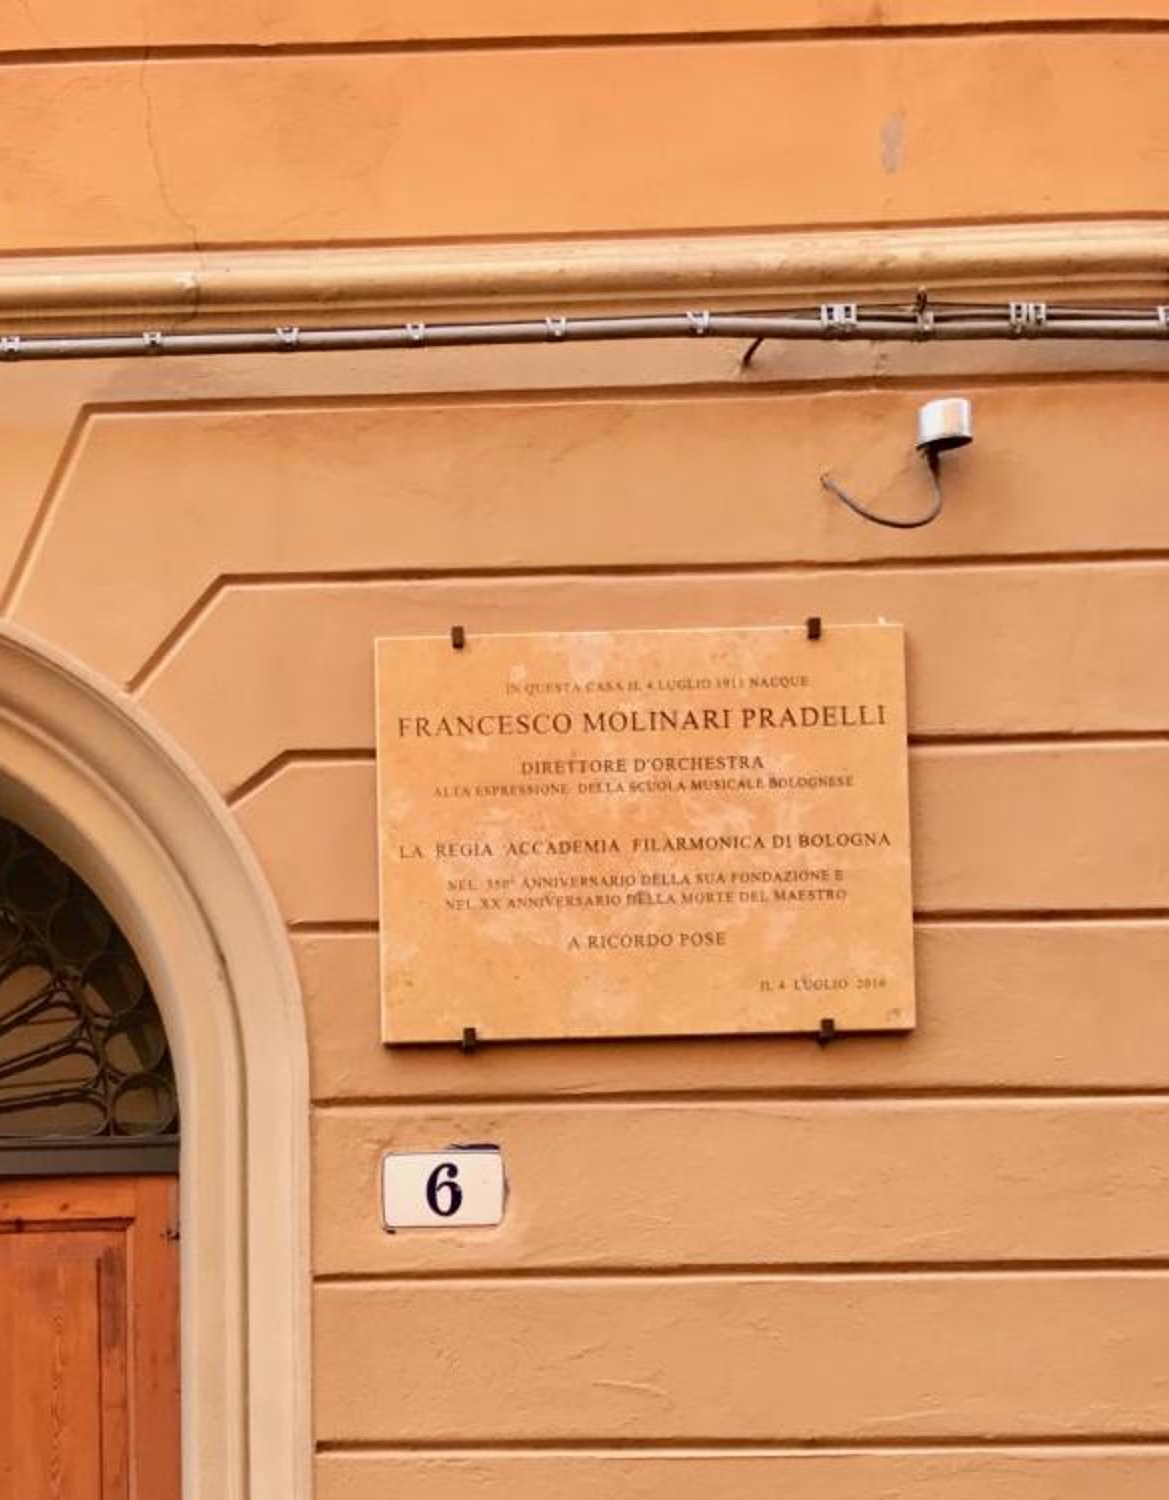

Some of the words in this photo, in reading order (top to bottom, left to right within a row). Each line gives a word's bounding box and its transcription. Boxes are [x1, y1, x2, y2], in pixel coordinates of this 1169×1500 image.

[506, 683, 521, 695] IN
[524, 682, 581, 697] QUESTA
[586, 681, 623, 693] CASA
[627, 680, 642, 692] IL
[646, 680, 654, 691] 4
[658, 678, 711, 691] LUGLIO
[716, 677, 745, 690] 1911
[749, 676, 811, 689] NACQUE
[398, 713, 573, 738] FRANCESCO
[582, 708, 731, 734] MOLINARI
[742, 704, 887, 729] PRADELLI
[521, 759, 628, 775] DIRETTORE
[634, 755, 765, 772] D'ORCHESTRA
[434, 786, 471, 799] ALTA
[578, 782, 624, 795] DELLA
[628, 779, 684, 793] SCUOLA
[690, 777, 765, 791] MUSICALE
[768, 775, 854, 789] BOLOGNESE
[399, 845, 424, 859] LA
[435, 842, 493, 857] REGIA
[507, 838, 621, 856] ACCADEMIA
[632, 835, 766, 851] FILARMONICA
[772, 835, 792, 849] DI
[798, 833, 891, 848] BOLOGNA
[447, 879, 479, 892] NEL
[522, 874, 637, 889] ANNIVERSARIO
[641, 872, 691, 886] DELLA
[695, 871, 726, 885] SUA
[731, 869, 830, 884] FONDAZIONE
[834, 869, 844, 881] E
[446, 898, 471, 911] NEL
[479, 897, 506, 910] XX
[507, 894, 622, 909] ANNIVERSARIO
[626, 892, 677, 906] DELLA
[681, 890, 736, 904] MORTE
[739, 890, 768, 903] DEL
[774, 888, 847, 902] MAESTRO
[567, 935, 581, 950] A
[587, 933, 674, 949] RICORDO
[679, 931, 728, 946] POSE
[793, 978, 849, 991] LUGLIO
[426, 1162, 464, 1218] 6
